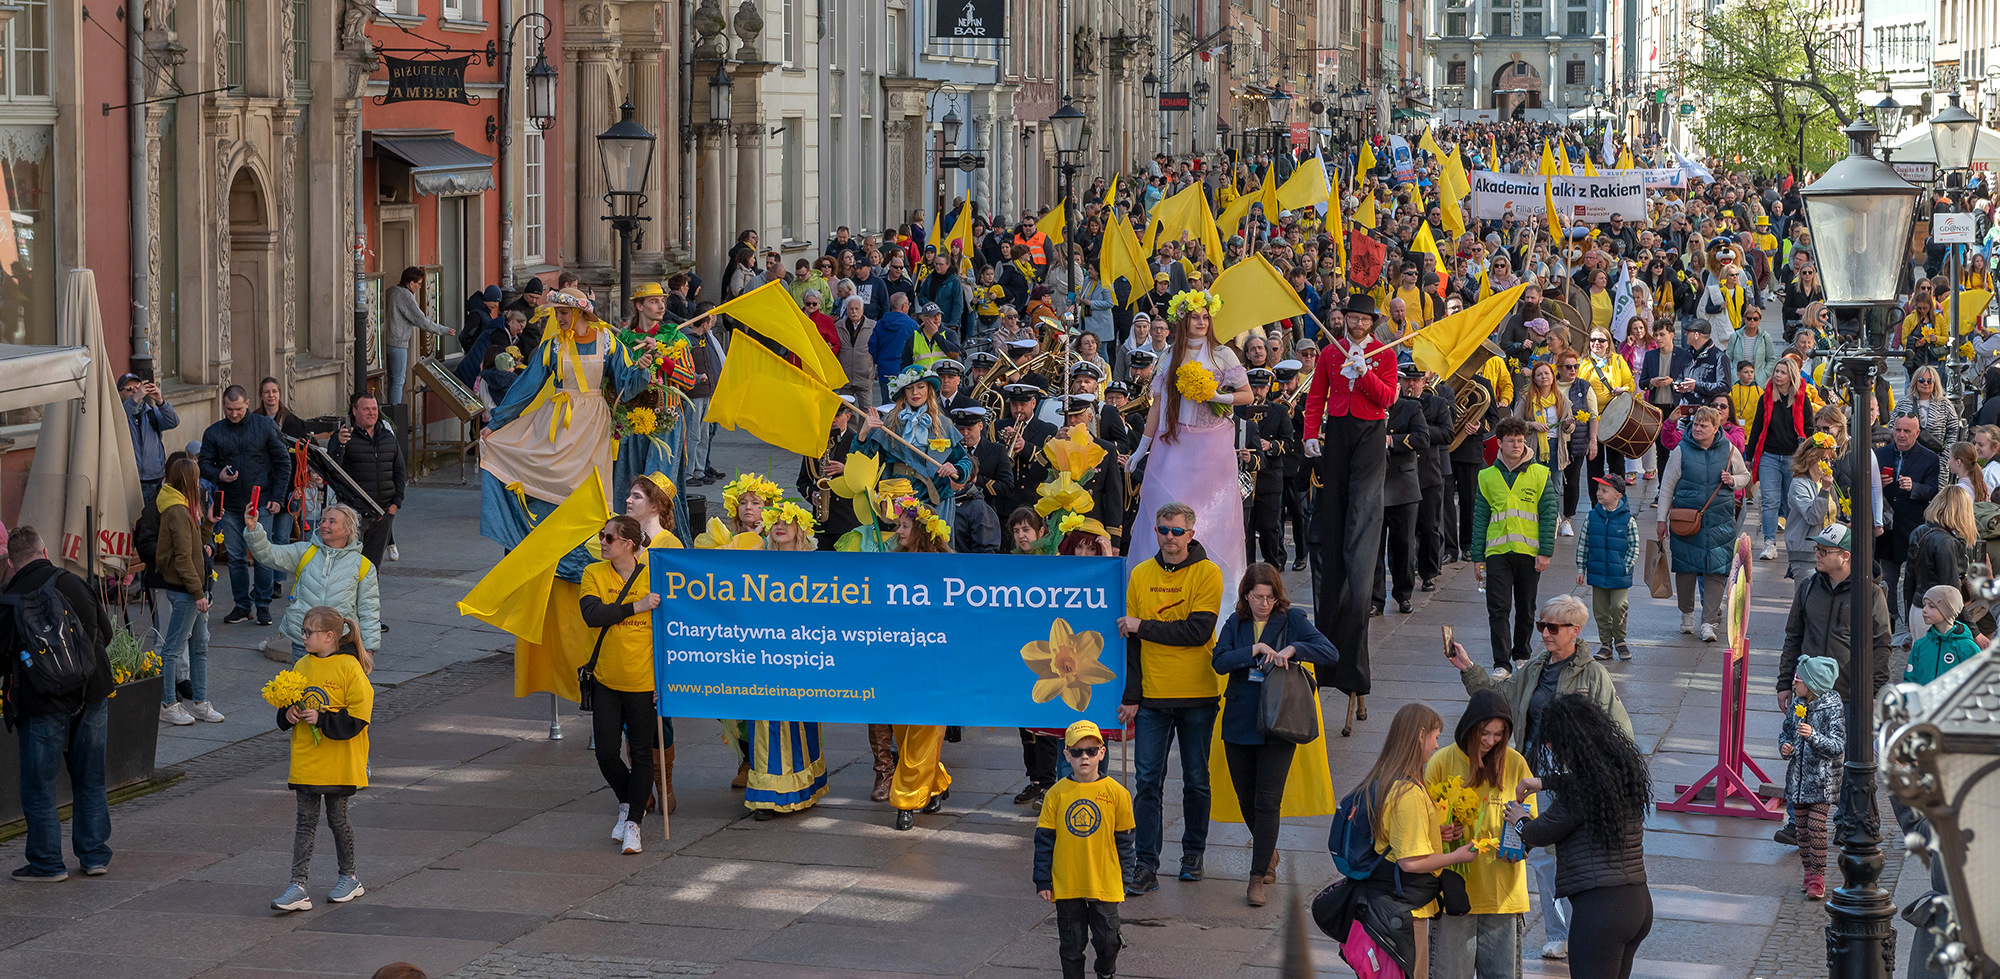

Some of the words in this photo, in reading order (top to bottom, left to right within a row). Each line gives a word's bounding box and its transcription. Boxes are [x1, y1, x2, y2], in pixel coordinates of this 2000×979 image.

[954, 27, 986, 36] BAR
[1475, 178, 1539, 195] Akademia
[1544, 182, 1575, 197] alki
[1579, 187, 1586, 198] z
[1590, 183, 1640, 198] Rakiem
[1515, 205, 1532, 213] Filia
[1533, 206, 1564, 215] Gdsk
[666, 572, 736, 601] Pola
[741, 574, 872, 604] Nadziei
[886, 583, 931, 606] na
[943, 577, 1108, 609] Pomorzu
[666, 621, 786, 642] Charytatywna
[791, 625, 837, 644] akcja
[841, 627, 947, 647] wspierająca
[666, 649, 757, 664] pomorskie
[761, 650, 836, 670] hospicja
[667, 683, 876, 701] www.polanadzieinapomorzu.pl
